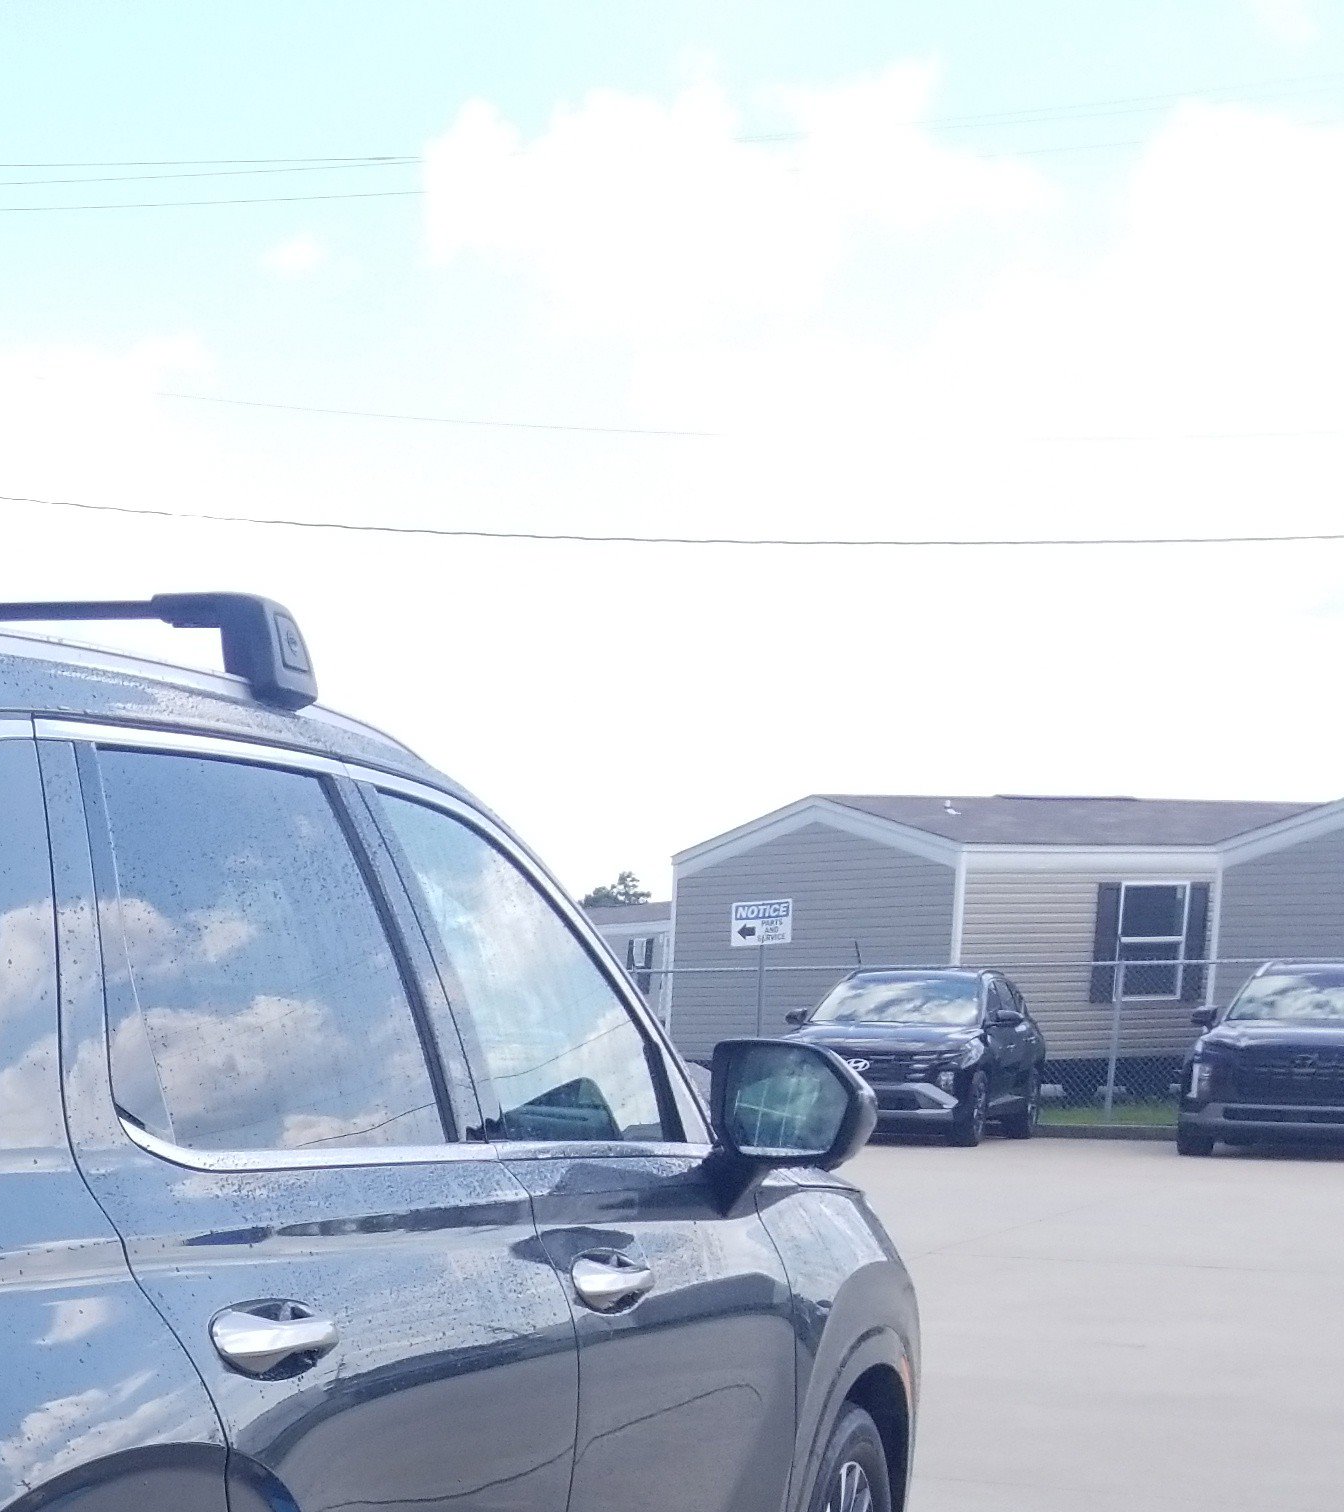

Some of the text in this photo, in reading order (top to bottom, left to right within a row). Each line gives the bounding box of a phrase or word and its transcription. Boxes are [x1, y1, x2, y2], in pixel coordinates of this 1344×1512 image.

[737, 904, 788, 918] NOTICE
[761, 918, 783, 926] PARTS
[757, 933, 786, 942] SERVICE
